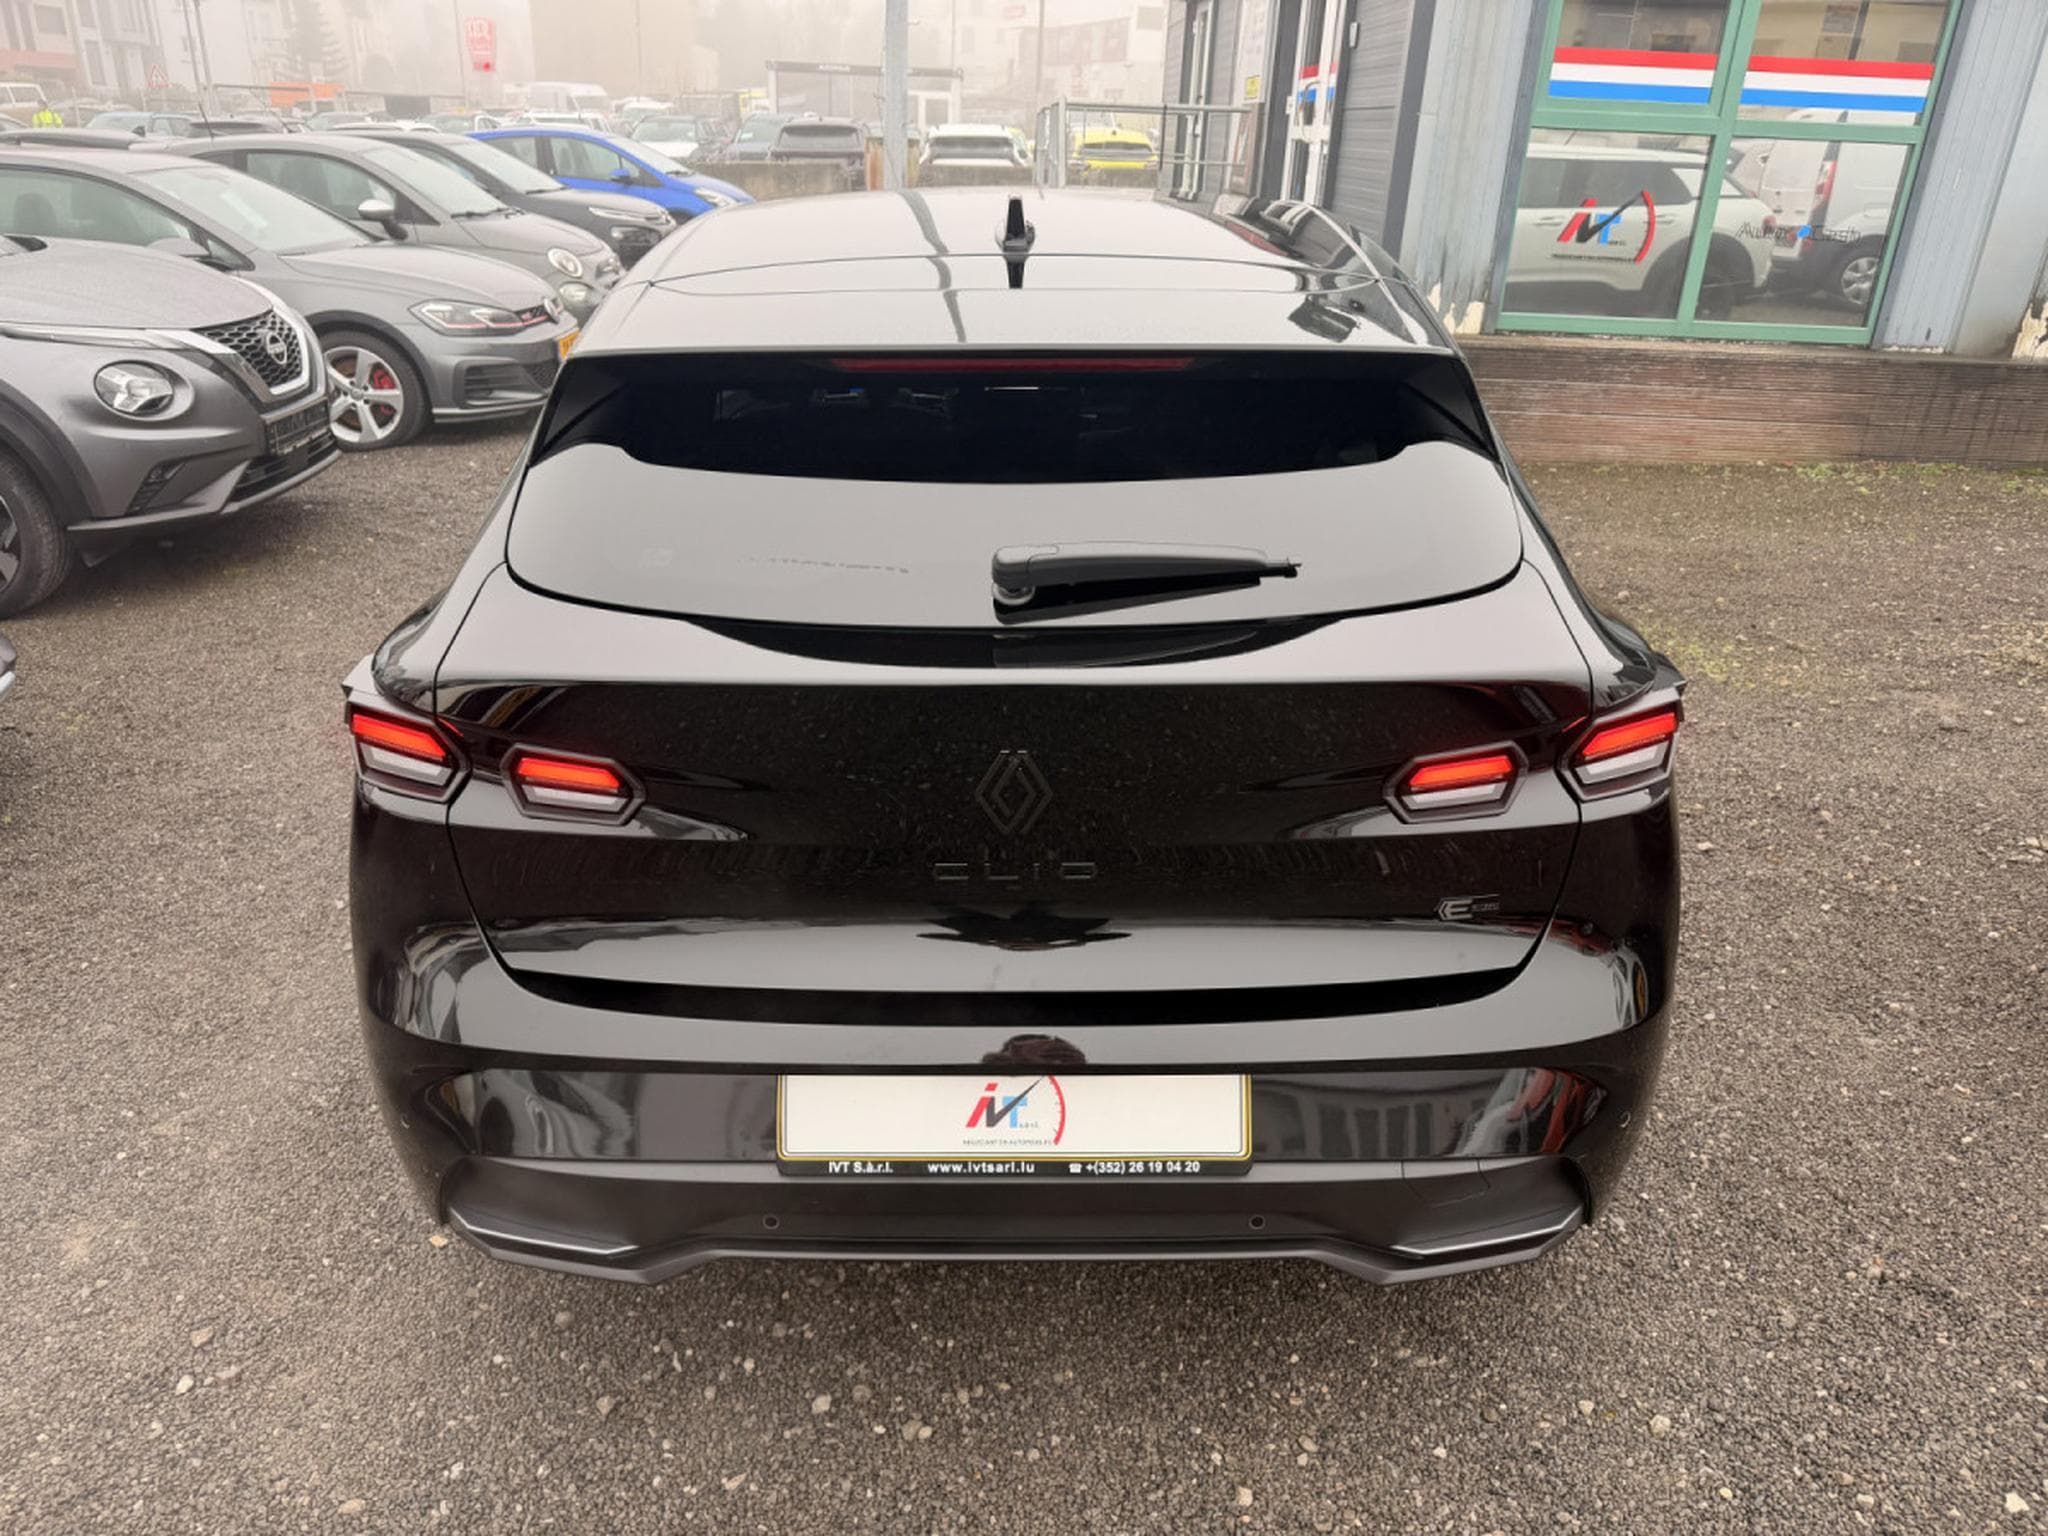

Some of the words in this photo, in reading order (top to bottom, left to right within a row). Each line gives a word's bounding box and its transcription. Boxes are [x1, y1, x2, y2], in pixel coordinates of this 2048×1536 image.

[828, 1161, 850, 1173] IVT
[927, 1161, 1035, 1173] www.ivtsarl.lu
[1086, 1161, 1126, 1175] +(352)
[1128, 1161, 1144, 1173] 26
[1148, 1161, 1163, 1173] 19
[1166, 1161, 1182, 1173] 04
[1184, 1161, 1200, 1173] 20
